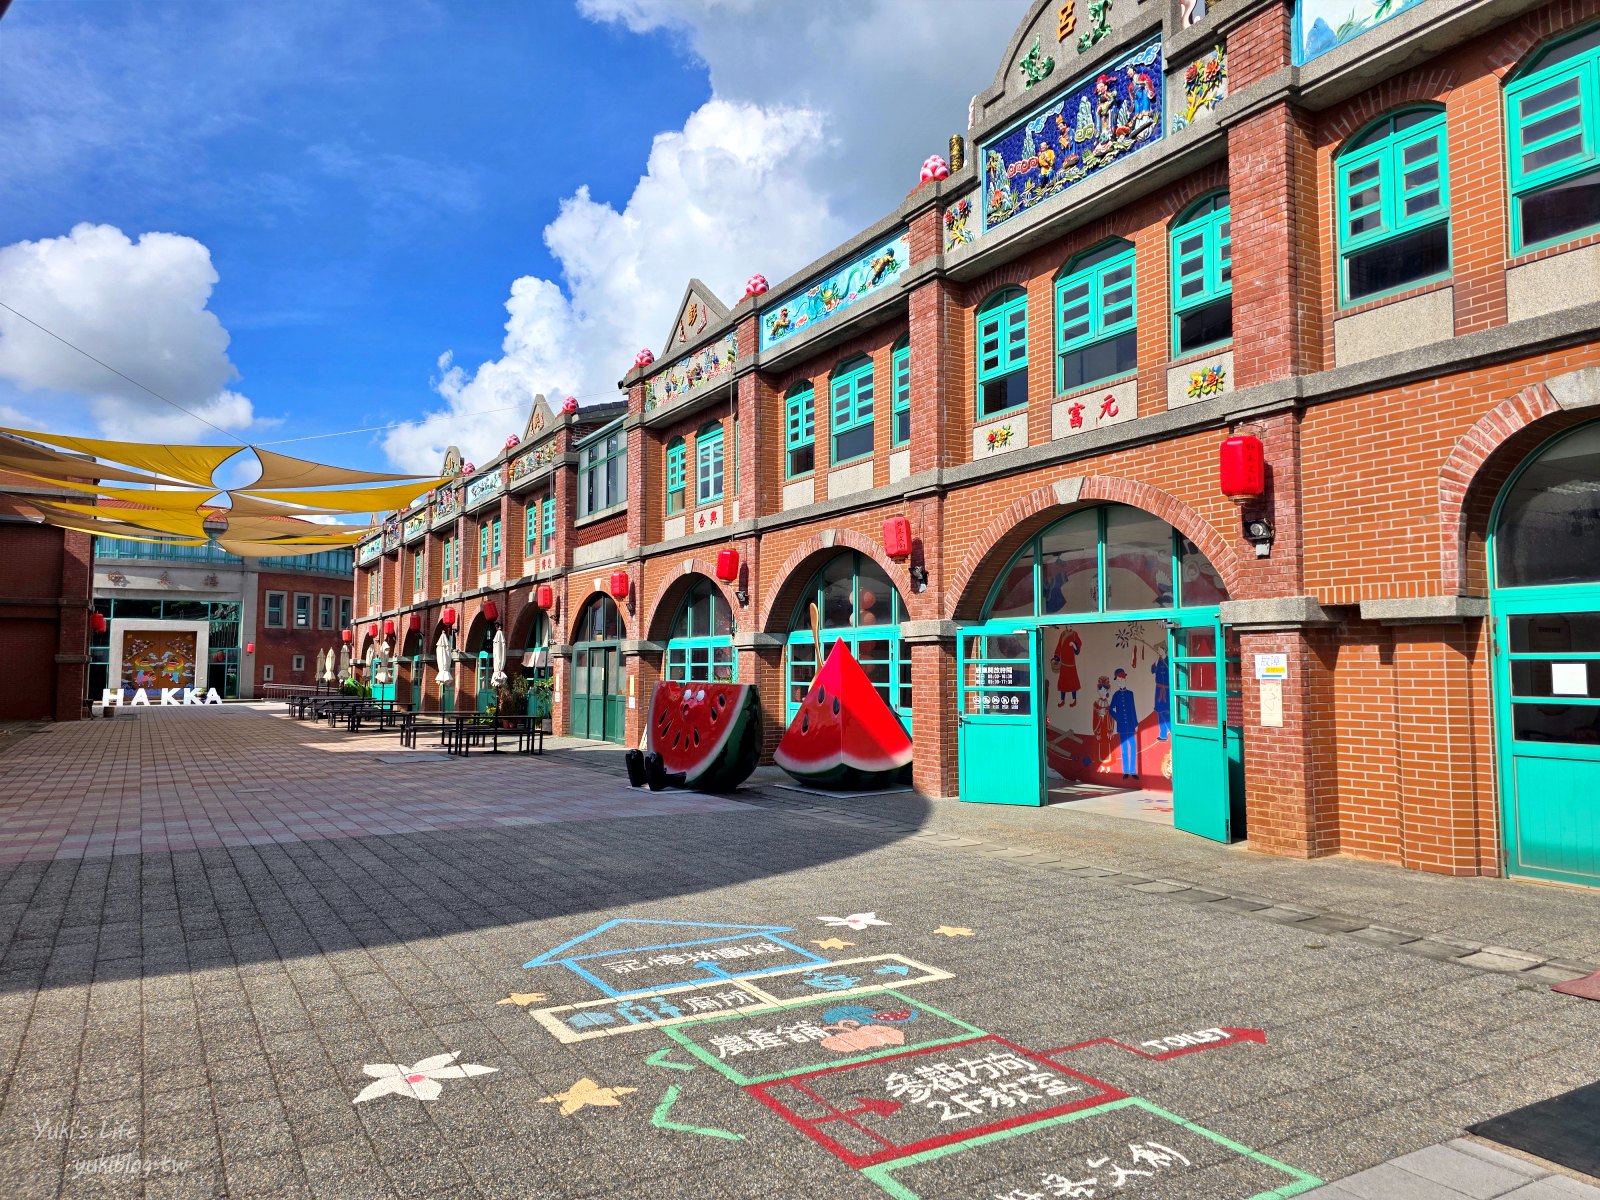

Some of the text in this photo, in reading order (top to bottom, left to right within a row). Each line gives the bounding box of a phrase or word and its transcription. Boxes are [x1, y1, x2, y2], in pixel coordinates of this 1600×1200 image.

[102, 687, 223, 706] HAKKA
[683, 989, 756, 1012] 廁所
[1141, 1028, 1231, 1051] TOILET
[884, 1053, 1038, 1104] 參觀方向
